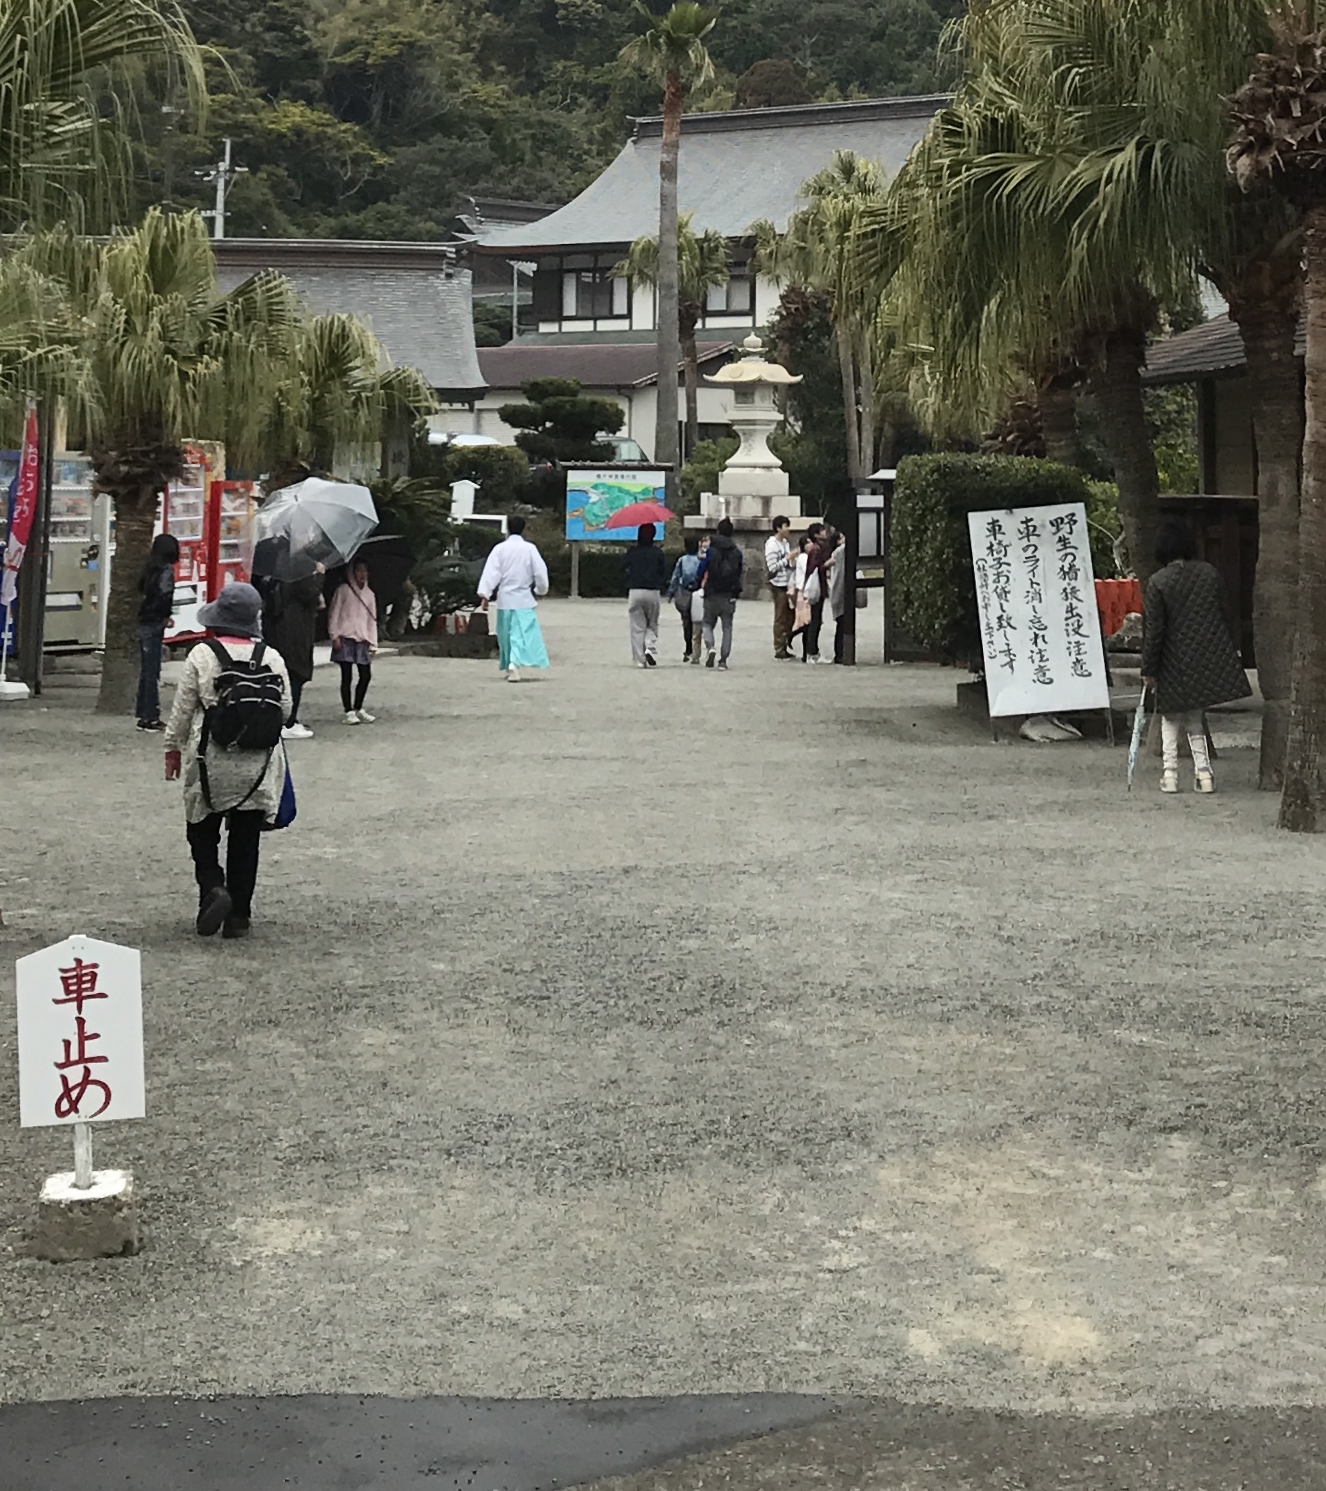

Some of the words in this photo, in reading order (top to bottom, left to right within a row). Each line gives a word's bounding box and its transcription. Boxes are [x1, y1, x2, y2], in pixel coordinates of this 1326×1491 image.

[1017, 516, 1054, 685] 車のライト消し忘れ注意
[51, 957, 112, 1119] 車止め
